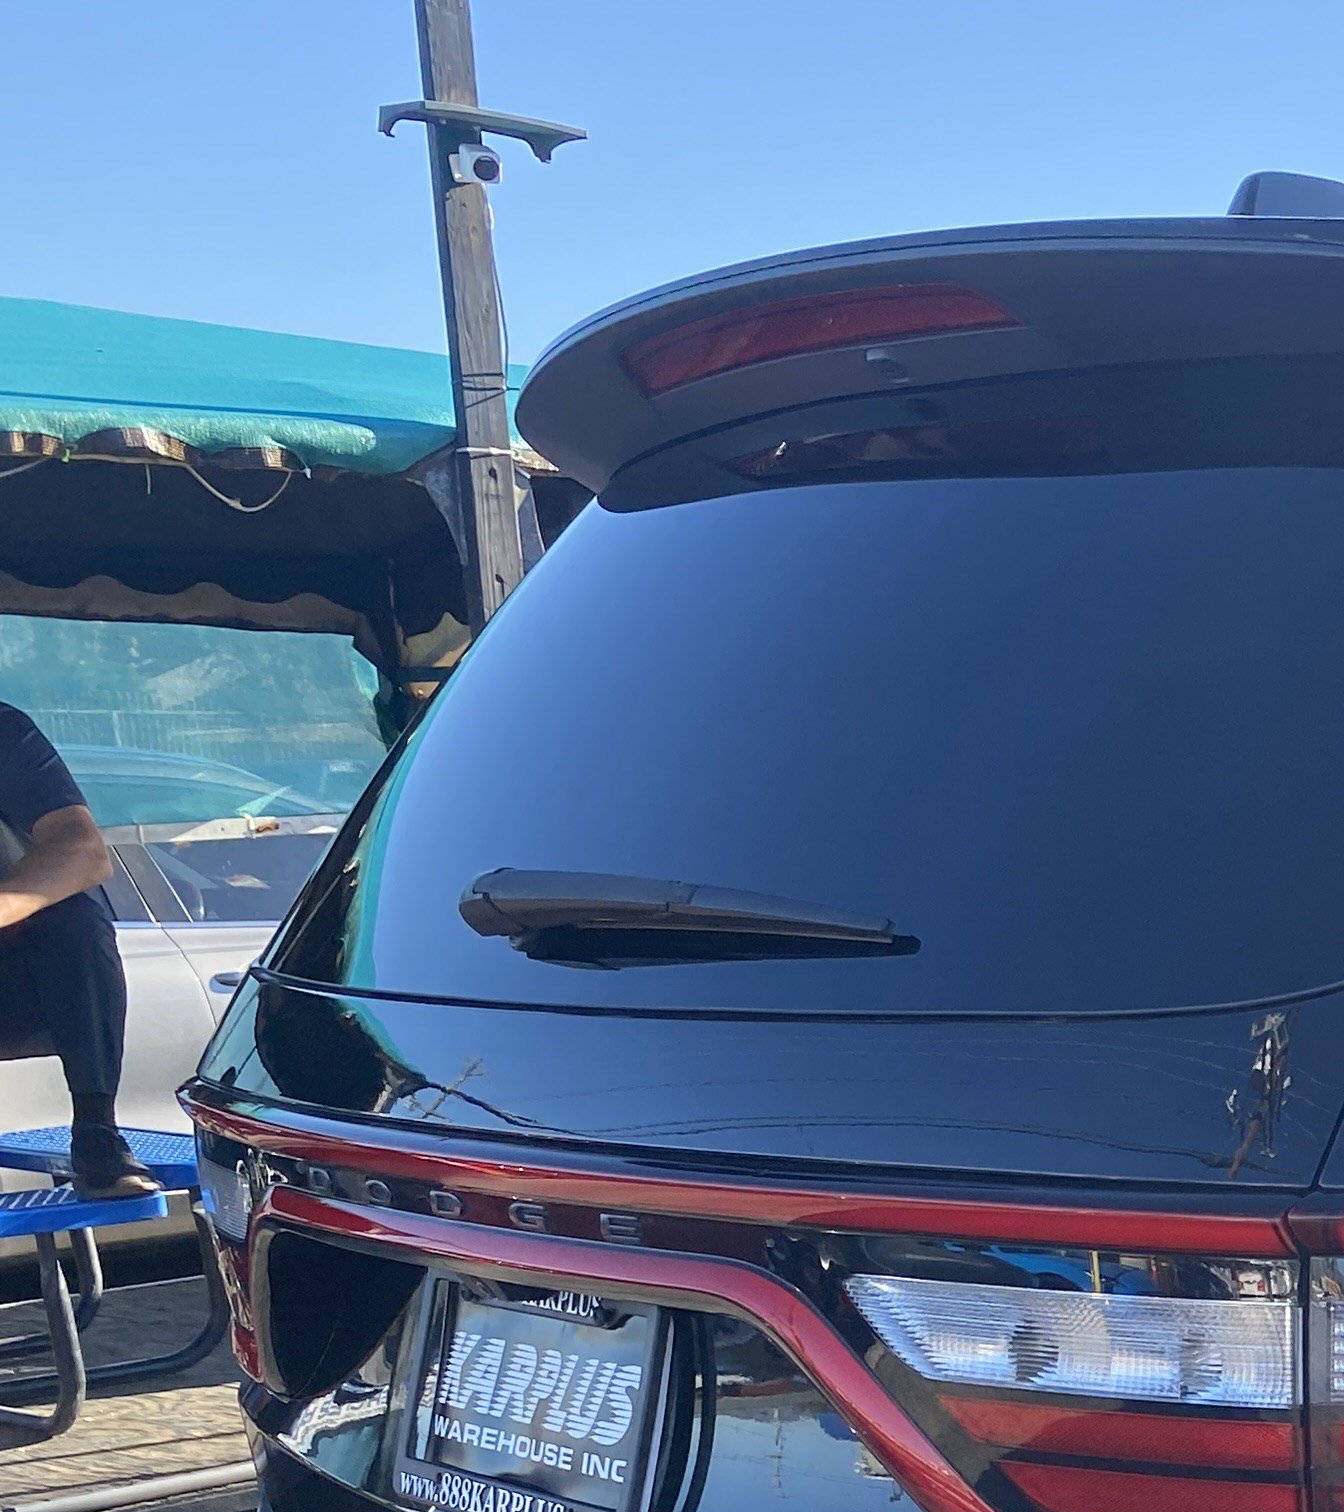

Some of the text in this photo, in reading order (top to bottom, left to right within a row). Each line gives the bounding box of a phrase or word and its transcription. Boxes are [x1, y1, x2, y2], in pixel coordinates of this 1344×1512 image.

[307, 1166, 643, 1244] DODGE
[437, 1329, 643, 1447] KARPLUS
[433, 1413, 628, 1484] WAREHOUSE INC
